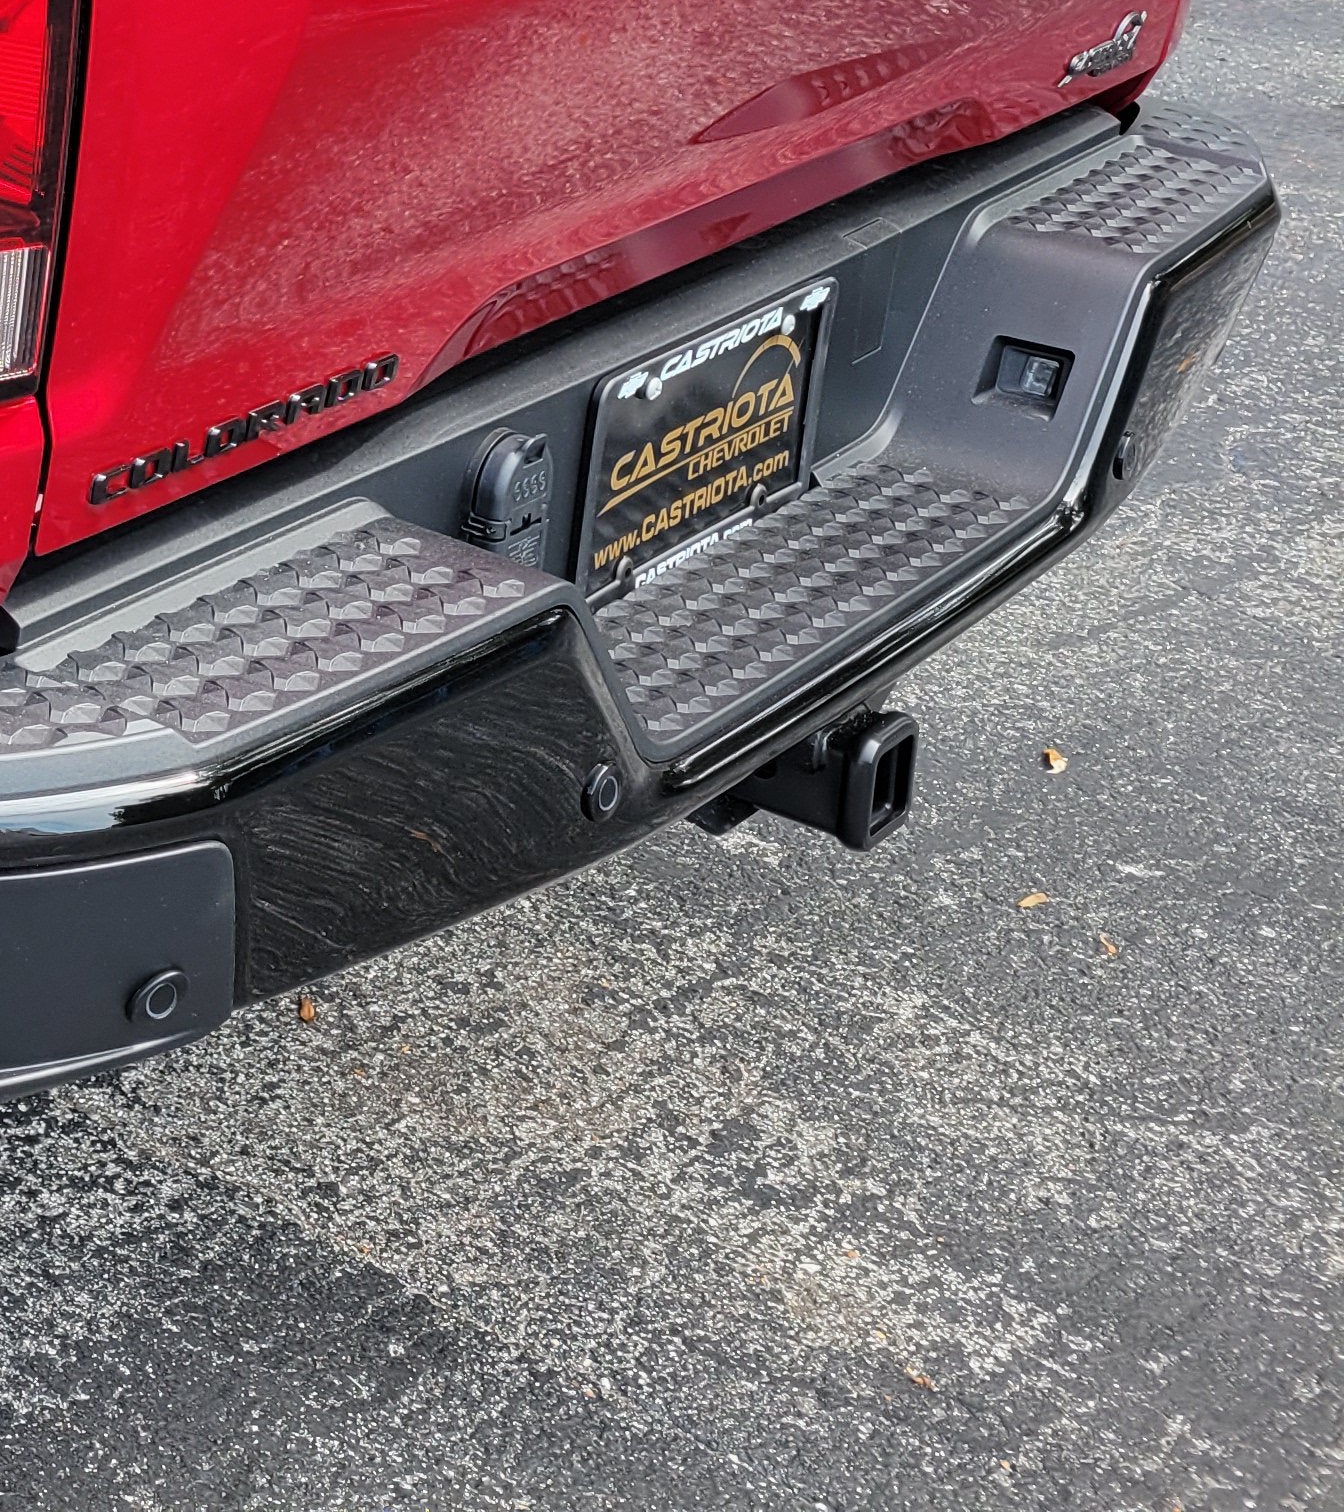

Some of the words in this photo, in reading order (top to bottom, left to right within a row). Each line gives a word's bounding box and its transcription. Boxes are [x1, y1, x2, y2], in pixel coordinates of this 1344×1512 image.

[660, 306, 784, 382] CASTRIOTA
[89, 351, 400, 505] COLORADO
[610, 373, 795, 491] CASTRIOTA
[687, 412, 792, 481] CHEVROLET
[593, 449, 790, 570] www.CASTRIOTA.com
